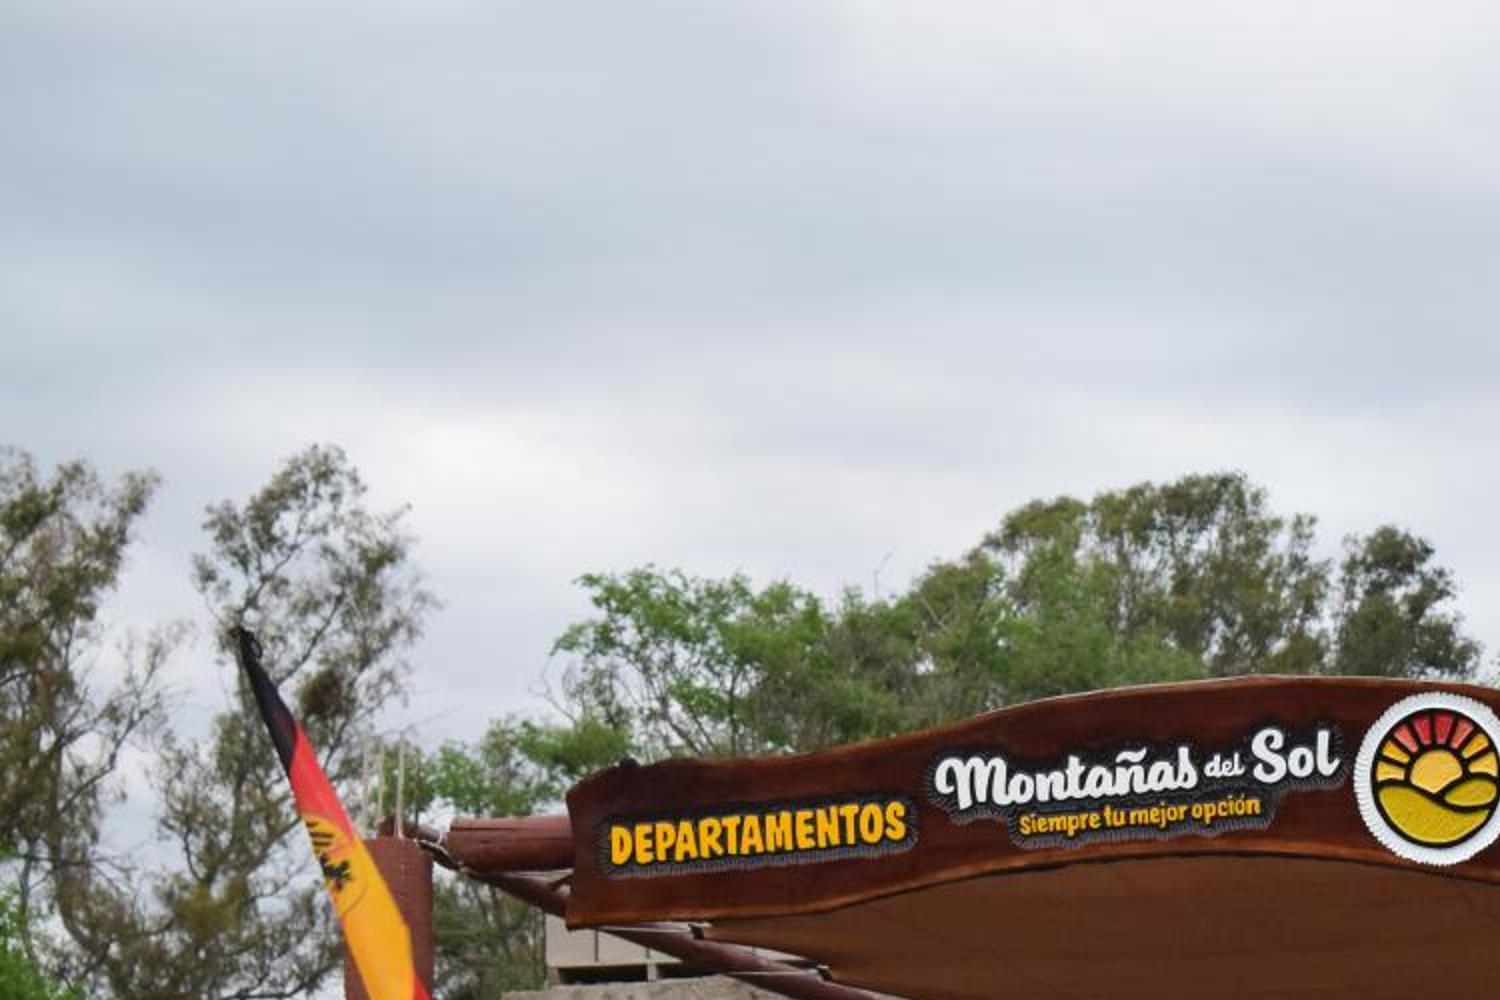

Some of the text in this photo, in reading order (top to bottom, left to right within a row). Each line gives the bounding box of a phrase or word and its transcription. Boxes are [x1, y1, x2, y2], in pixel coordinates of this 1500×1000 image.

[934, 728, 1340, 810] Montañas del Sol
[610, 801, 906, 865] DEPARTAMENTOS
[1103, 804, 1126, 827] tu
[1129, 802, 1187, 829] mejor
[1191, 794, 1261, 824] opción
